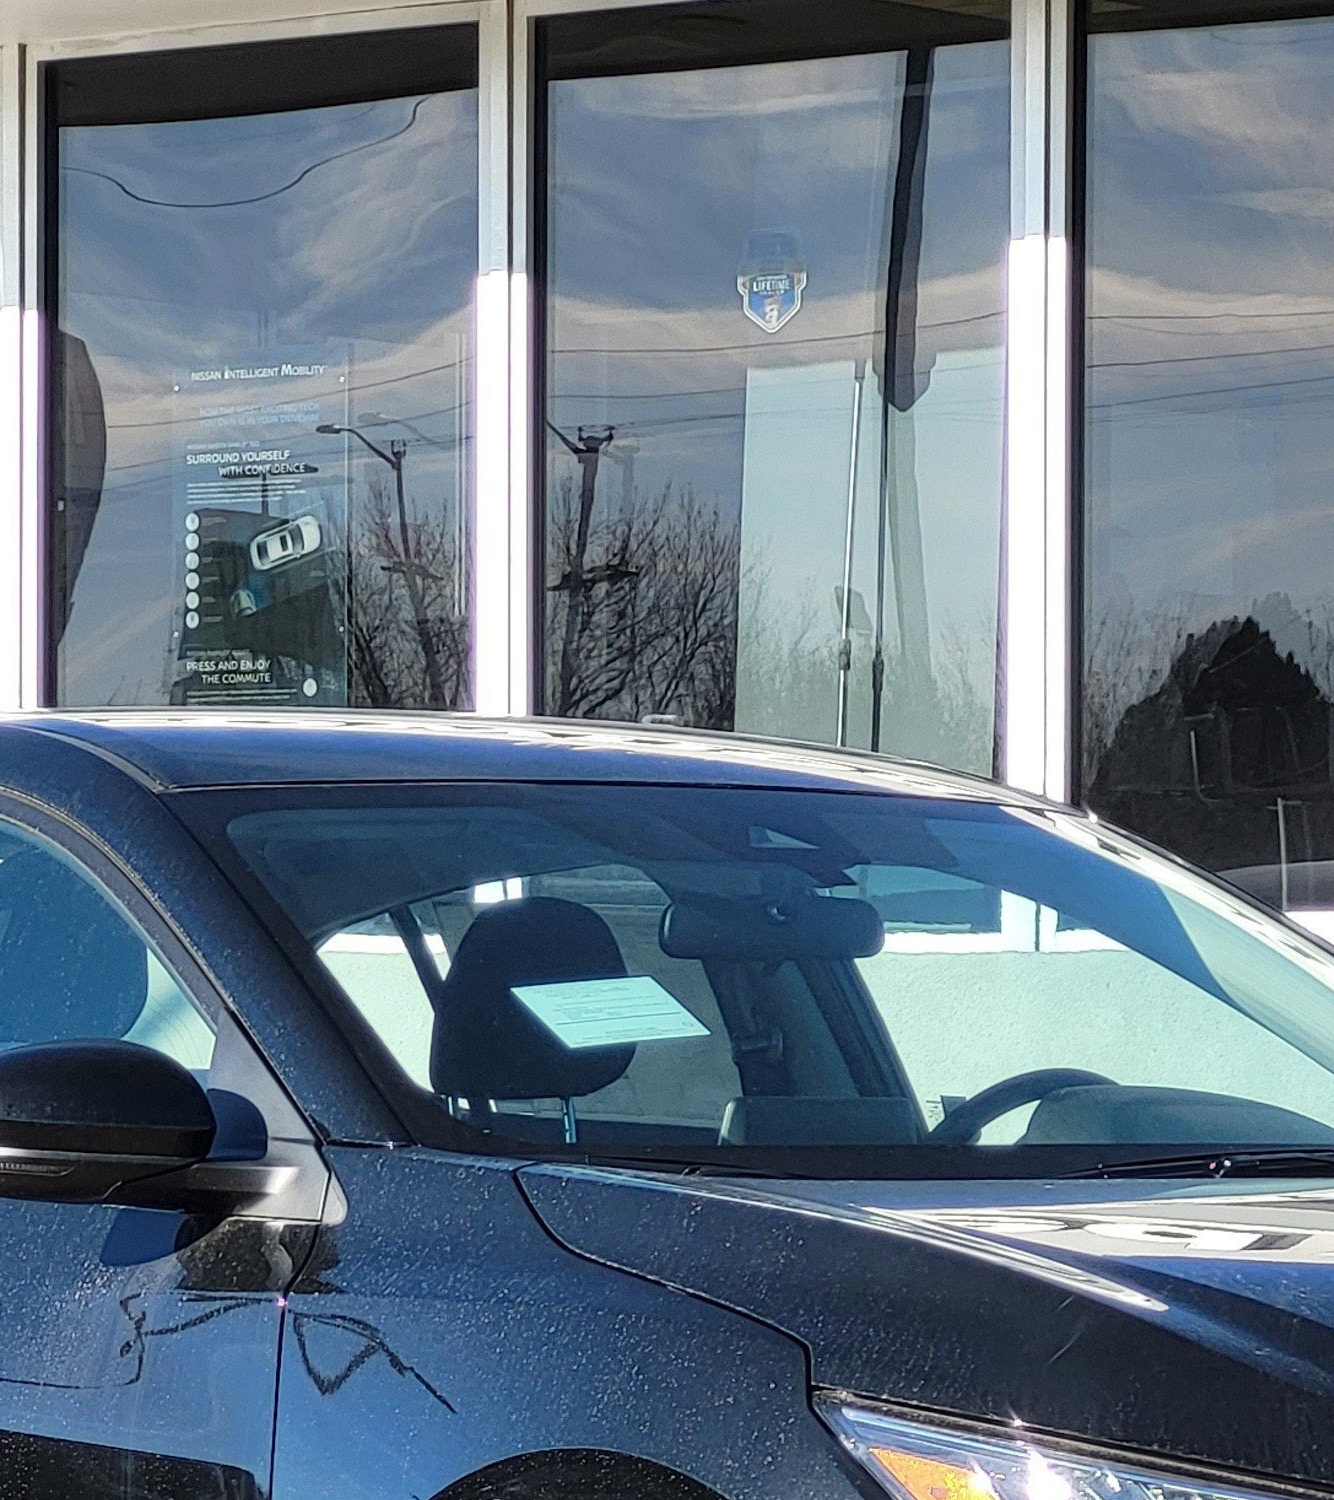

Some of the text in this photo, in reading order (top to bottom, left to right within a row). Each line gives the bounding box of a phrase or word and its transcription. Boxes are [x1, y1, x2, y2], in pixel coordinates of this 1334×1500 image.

[186, 450, 291, 465] SURROUND YOURSELF
[218, 465, 243, 475] WITH
[186, 659, 271, 672] PRESS AND ENJOY
[201, 672, 271, 684] THE COMMUTE
